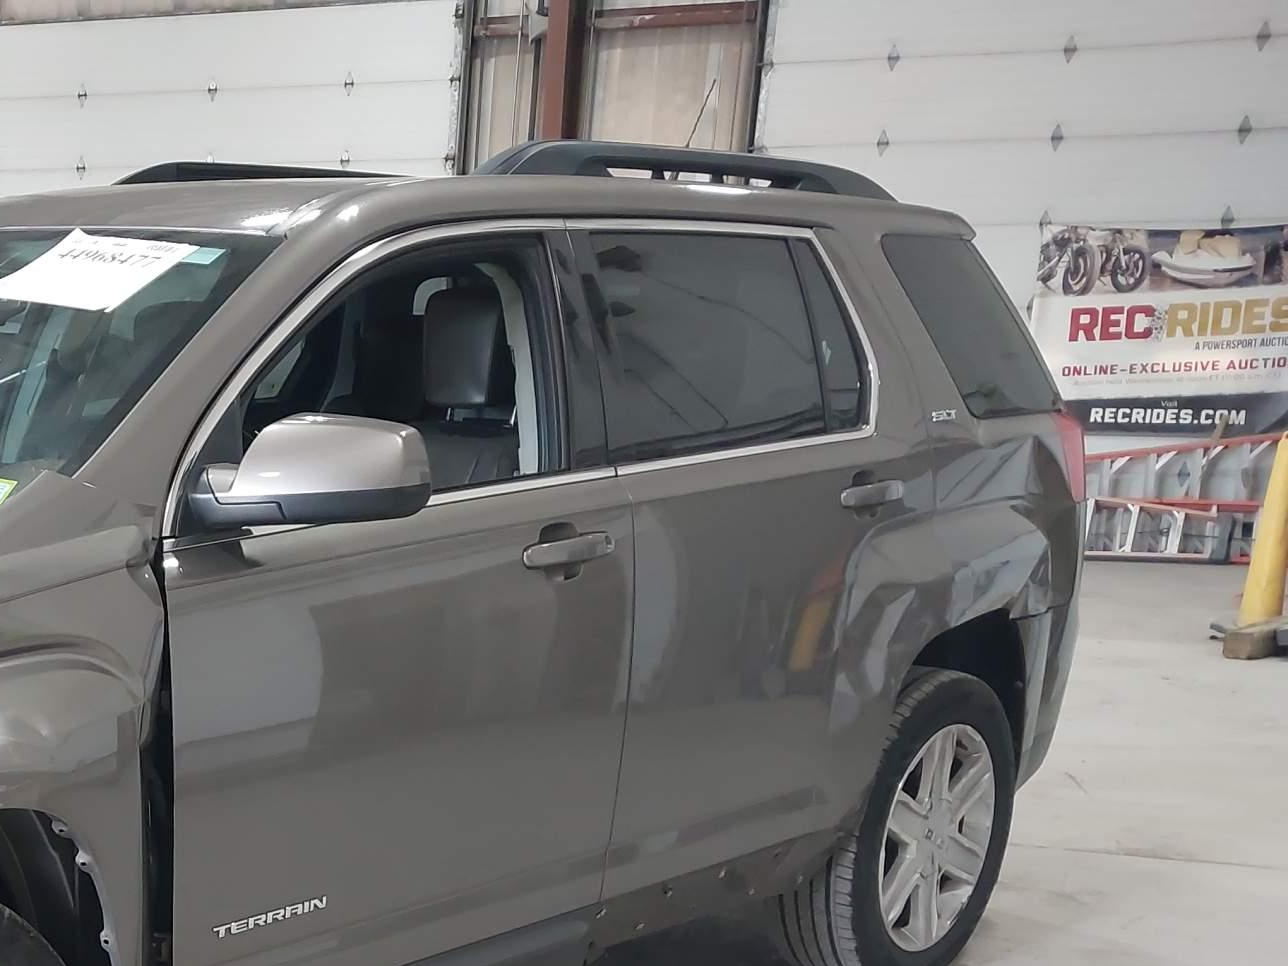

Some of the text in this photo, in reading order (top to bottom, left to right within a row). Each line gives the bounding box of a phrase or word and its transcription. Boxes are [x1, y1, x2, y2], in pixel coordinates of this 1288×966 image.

[59, 249, 162, 268] 44968477
[1068, 296, 1288, 342] REC RIDES
[1195, 342, 1201, 350] A
[1202, 338, 1257, 350] POWERSPORT
[1062, 360, 1220, 377] ONLINE-EXCLUSIVE
[931, 409, 957, 422] SLT
[1089, 407, 1247, 425] RECRIDES.COM
[213, 896, 328, 938] TERRAIN
